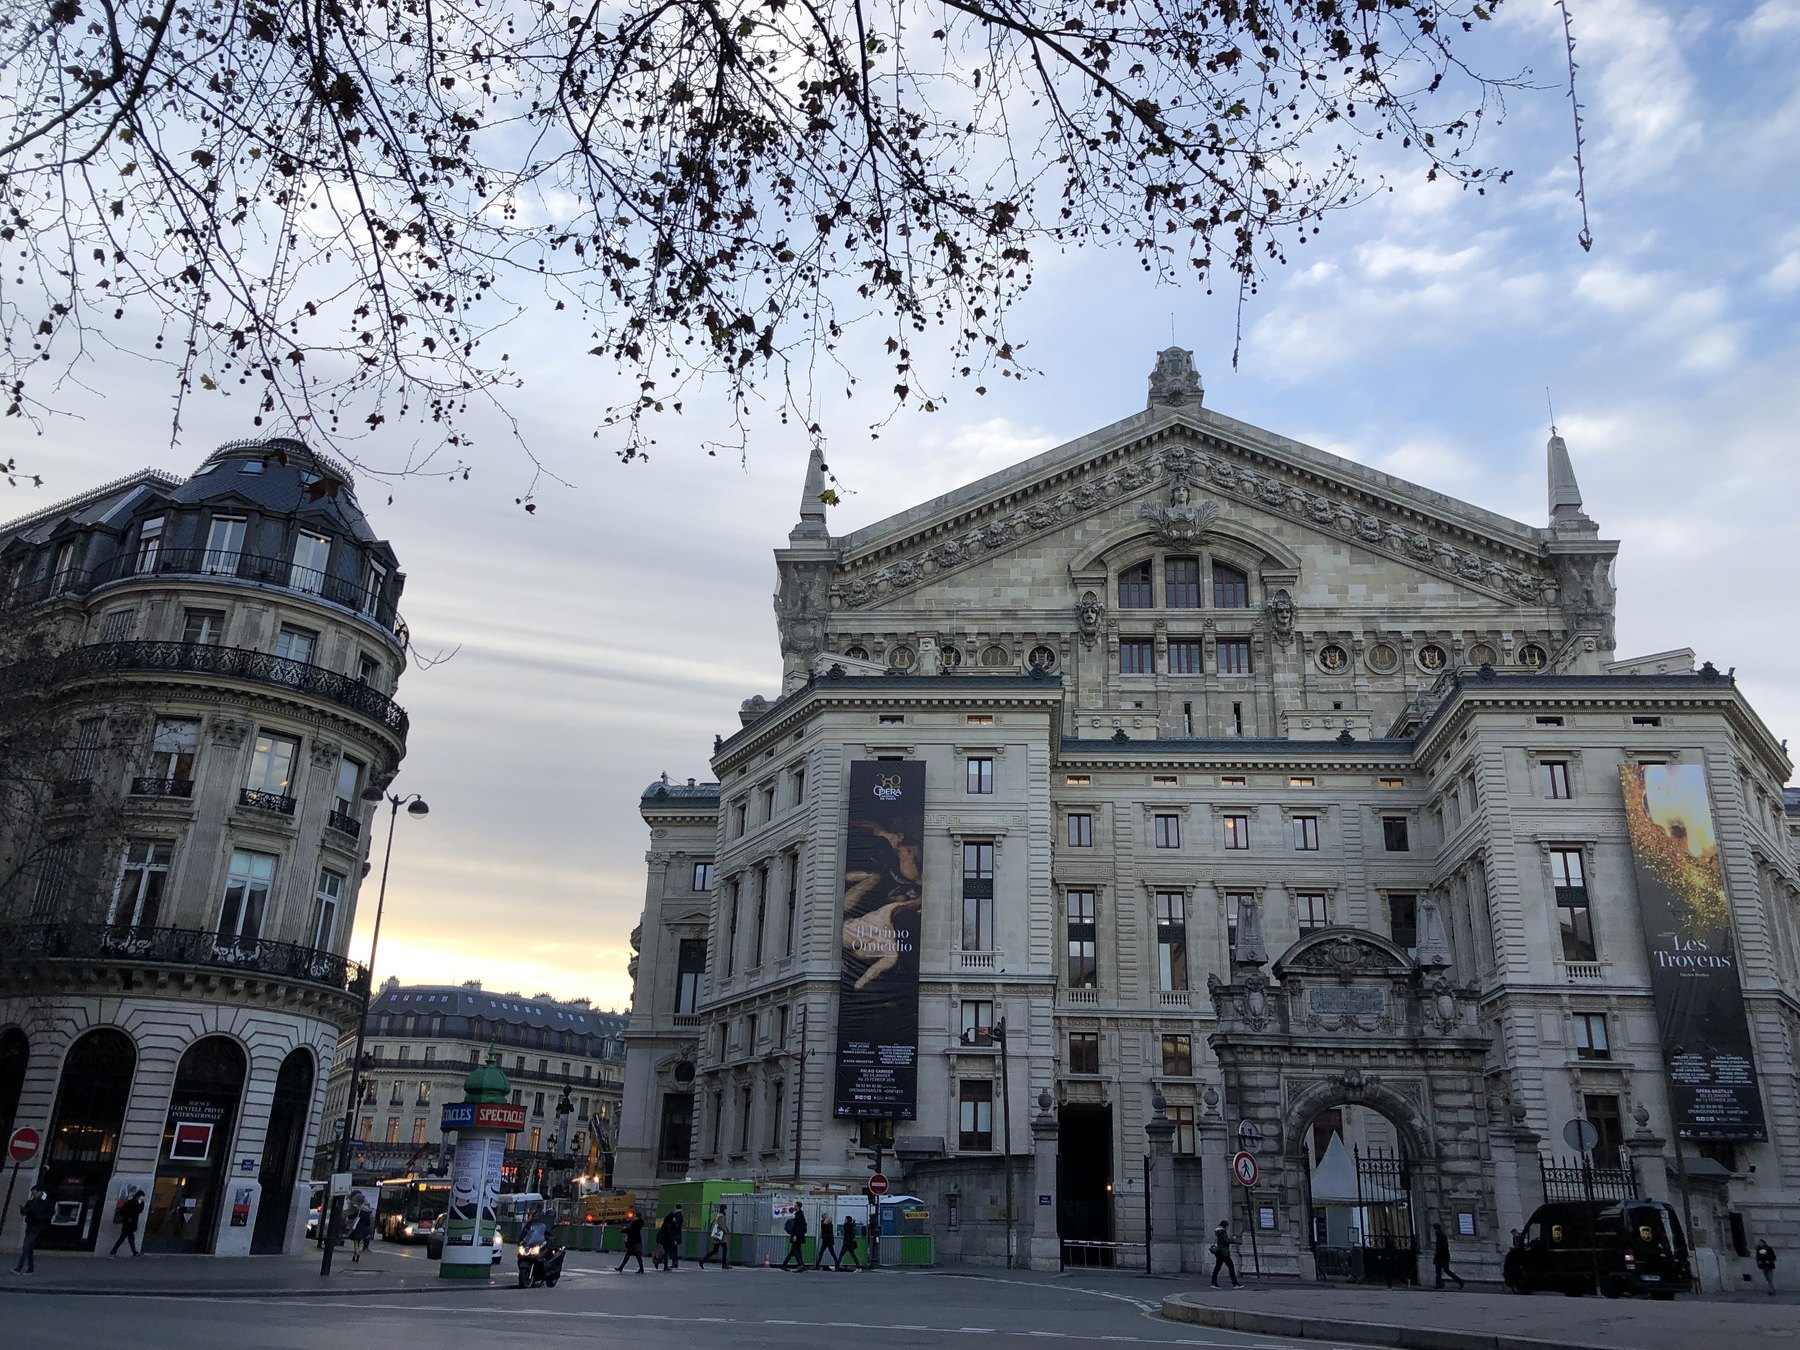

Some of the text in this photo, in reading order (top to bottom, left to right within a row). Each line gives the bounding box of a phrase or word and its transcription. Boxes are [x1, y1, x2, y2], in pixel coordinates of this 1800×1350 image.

[869, 925, 909, 938] Primo
[852, 939, 913, 952] Omicidio
[1673, 935, 1708, 951] Les
[1653, 950, 1732, 972] Troyens
